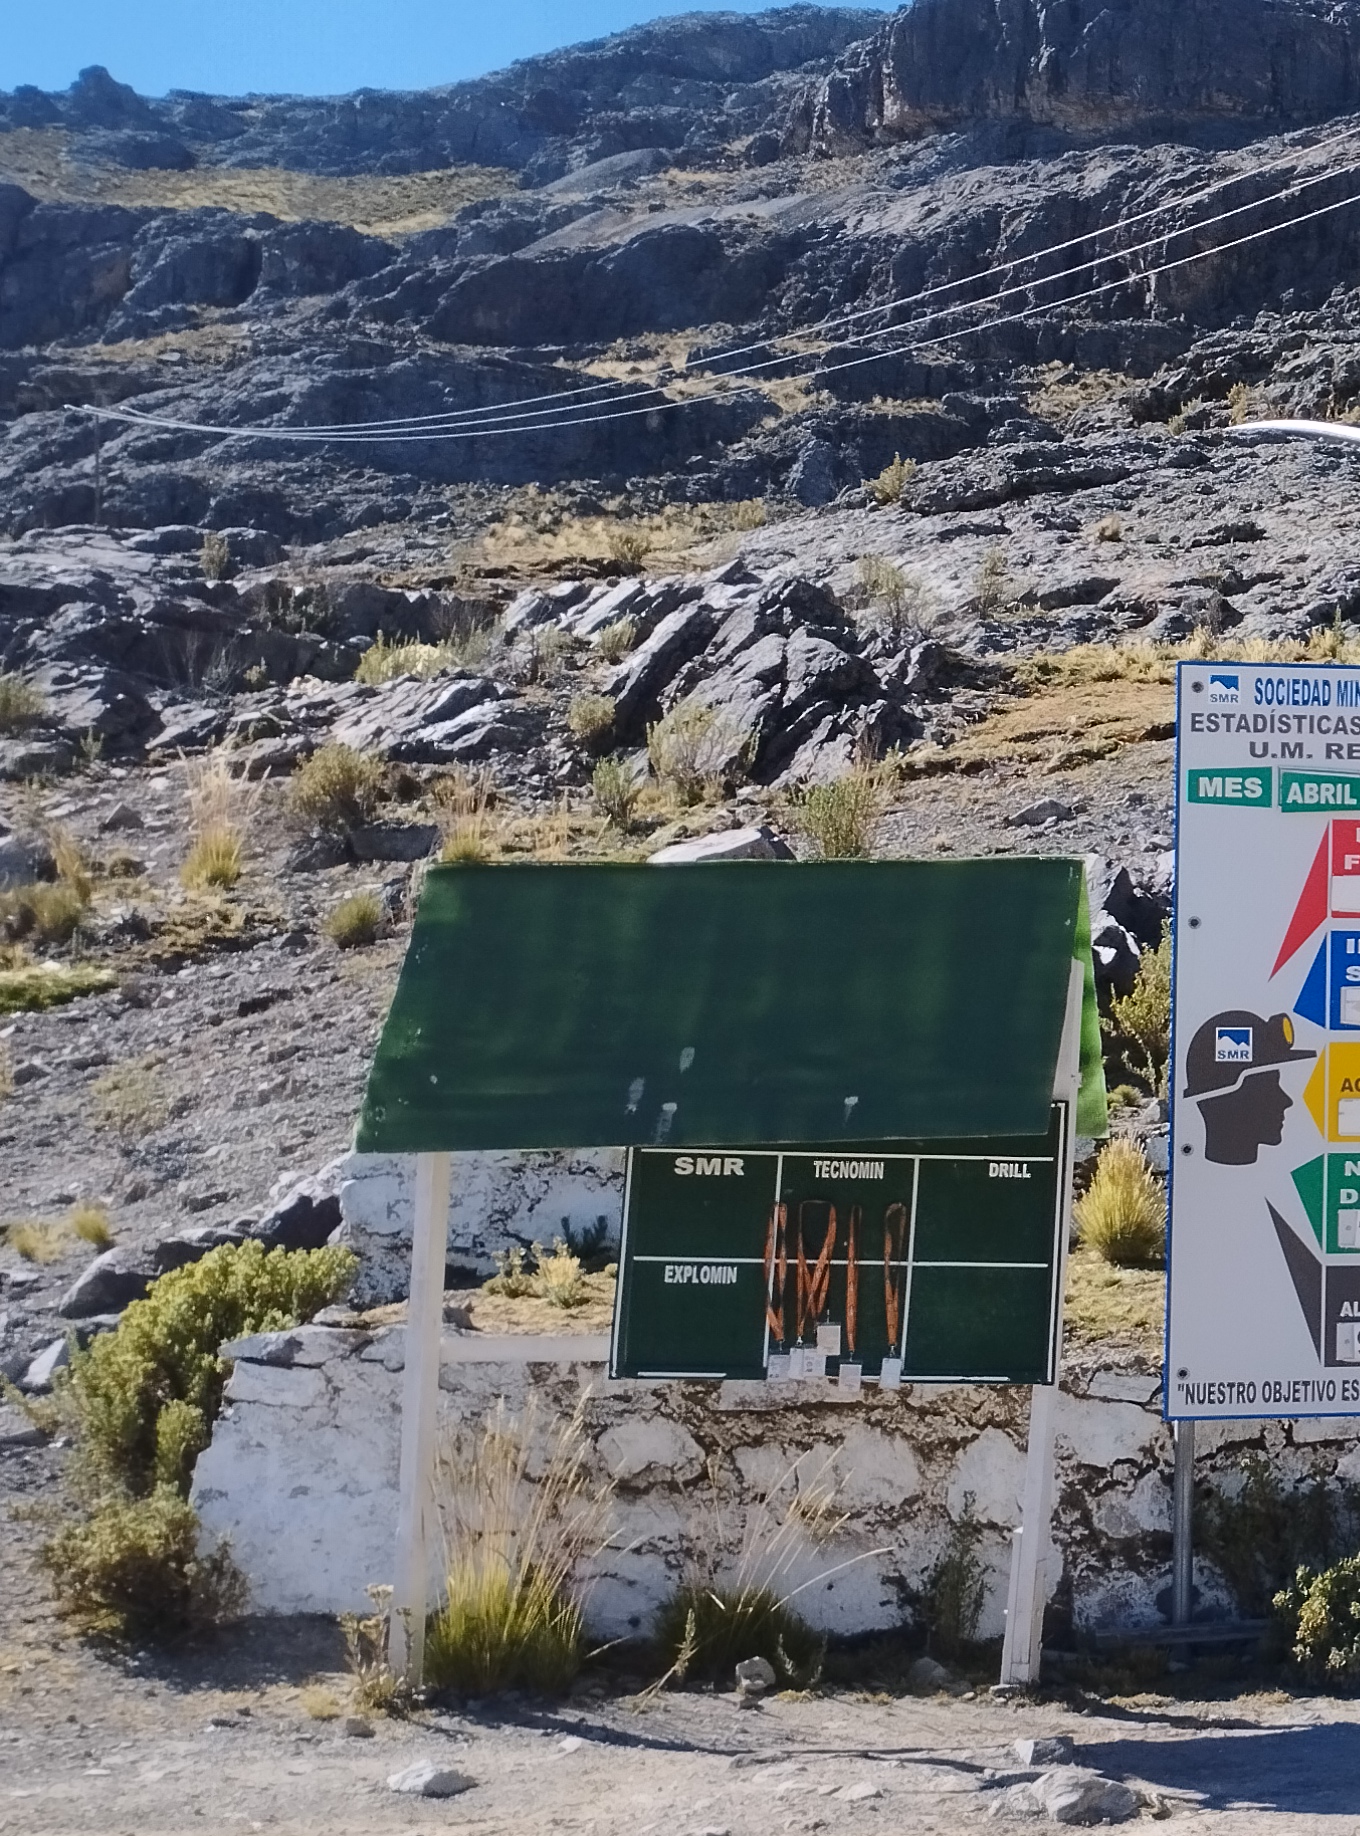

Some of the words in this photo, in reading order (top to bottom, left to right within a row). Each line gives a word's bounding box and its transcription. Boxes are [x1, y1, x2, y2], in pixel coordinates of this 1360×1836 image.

[1209, 692, 1239, 703] SMR
[1254, 677, 1331, 707] SOCIEDAD
[1249, 741, 1314, 759] U.M.
[1198, 777, 1263, 798] MES
[1286, 782, 1358, 805] ABRIL
[1217, 1049, 1249, 1060] SMR
[673, 1156, 745, 1177] SMR
[813, 1160, 884, 1180] TECNOMIN
[988, 1162, 1031, 1179] DRILL
[664, 1265, 737, 1285] EXPLOMIN
[1178, 1381, 1256, 1405] "NUESTRO
[1262, 1380, 1337, 1403] OBJETIVO
[1342, 1380, 1359, 1401] ES
